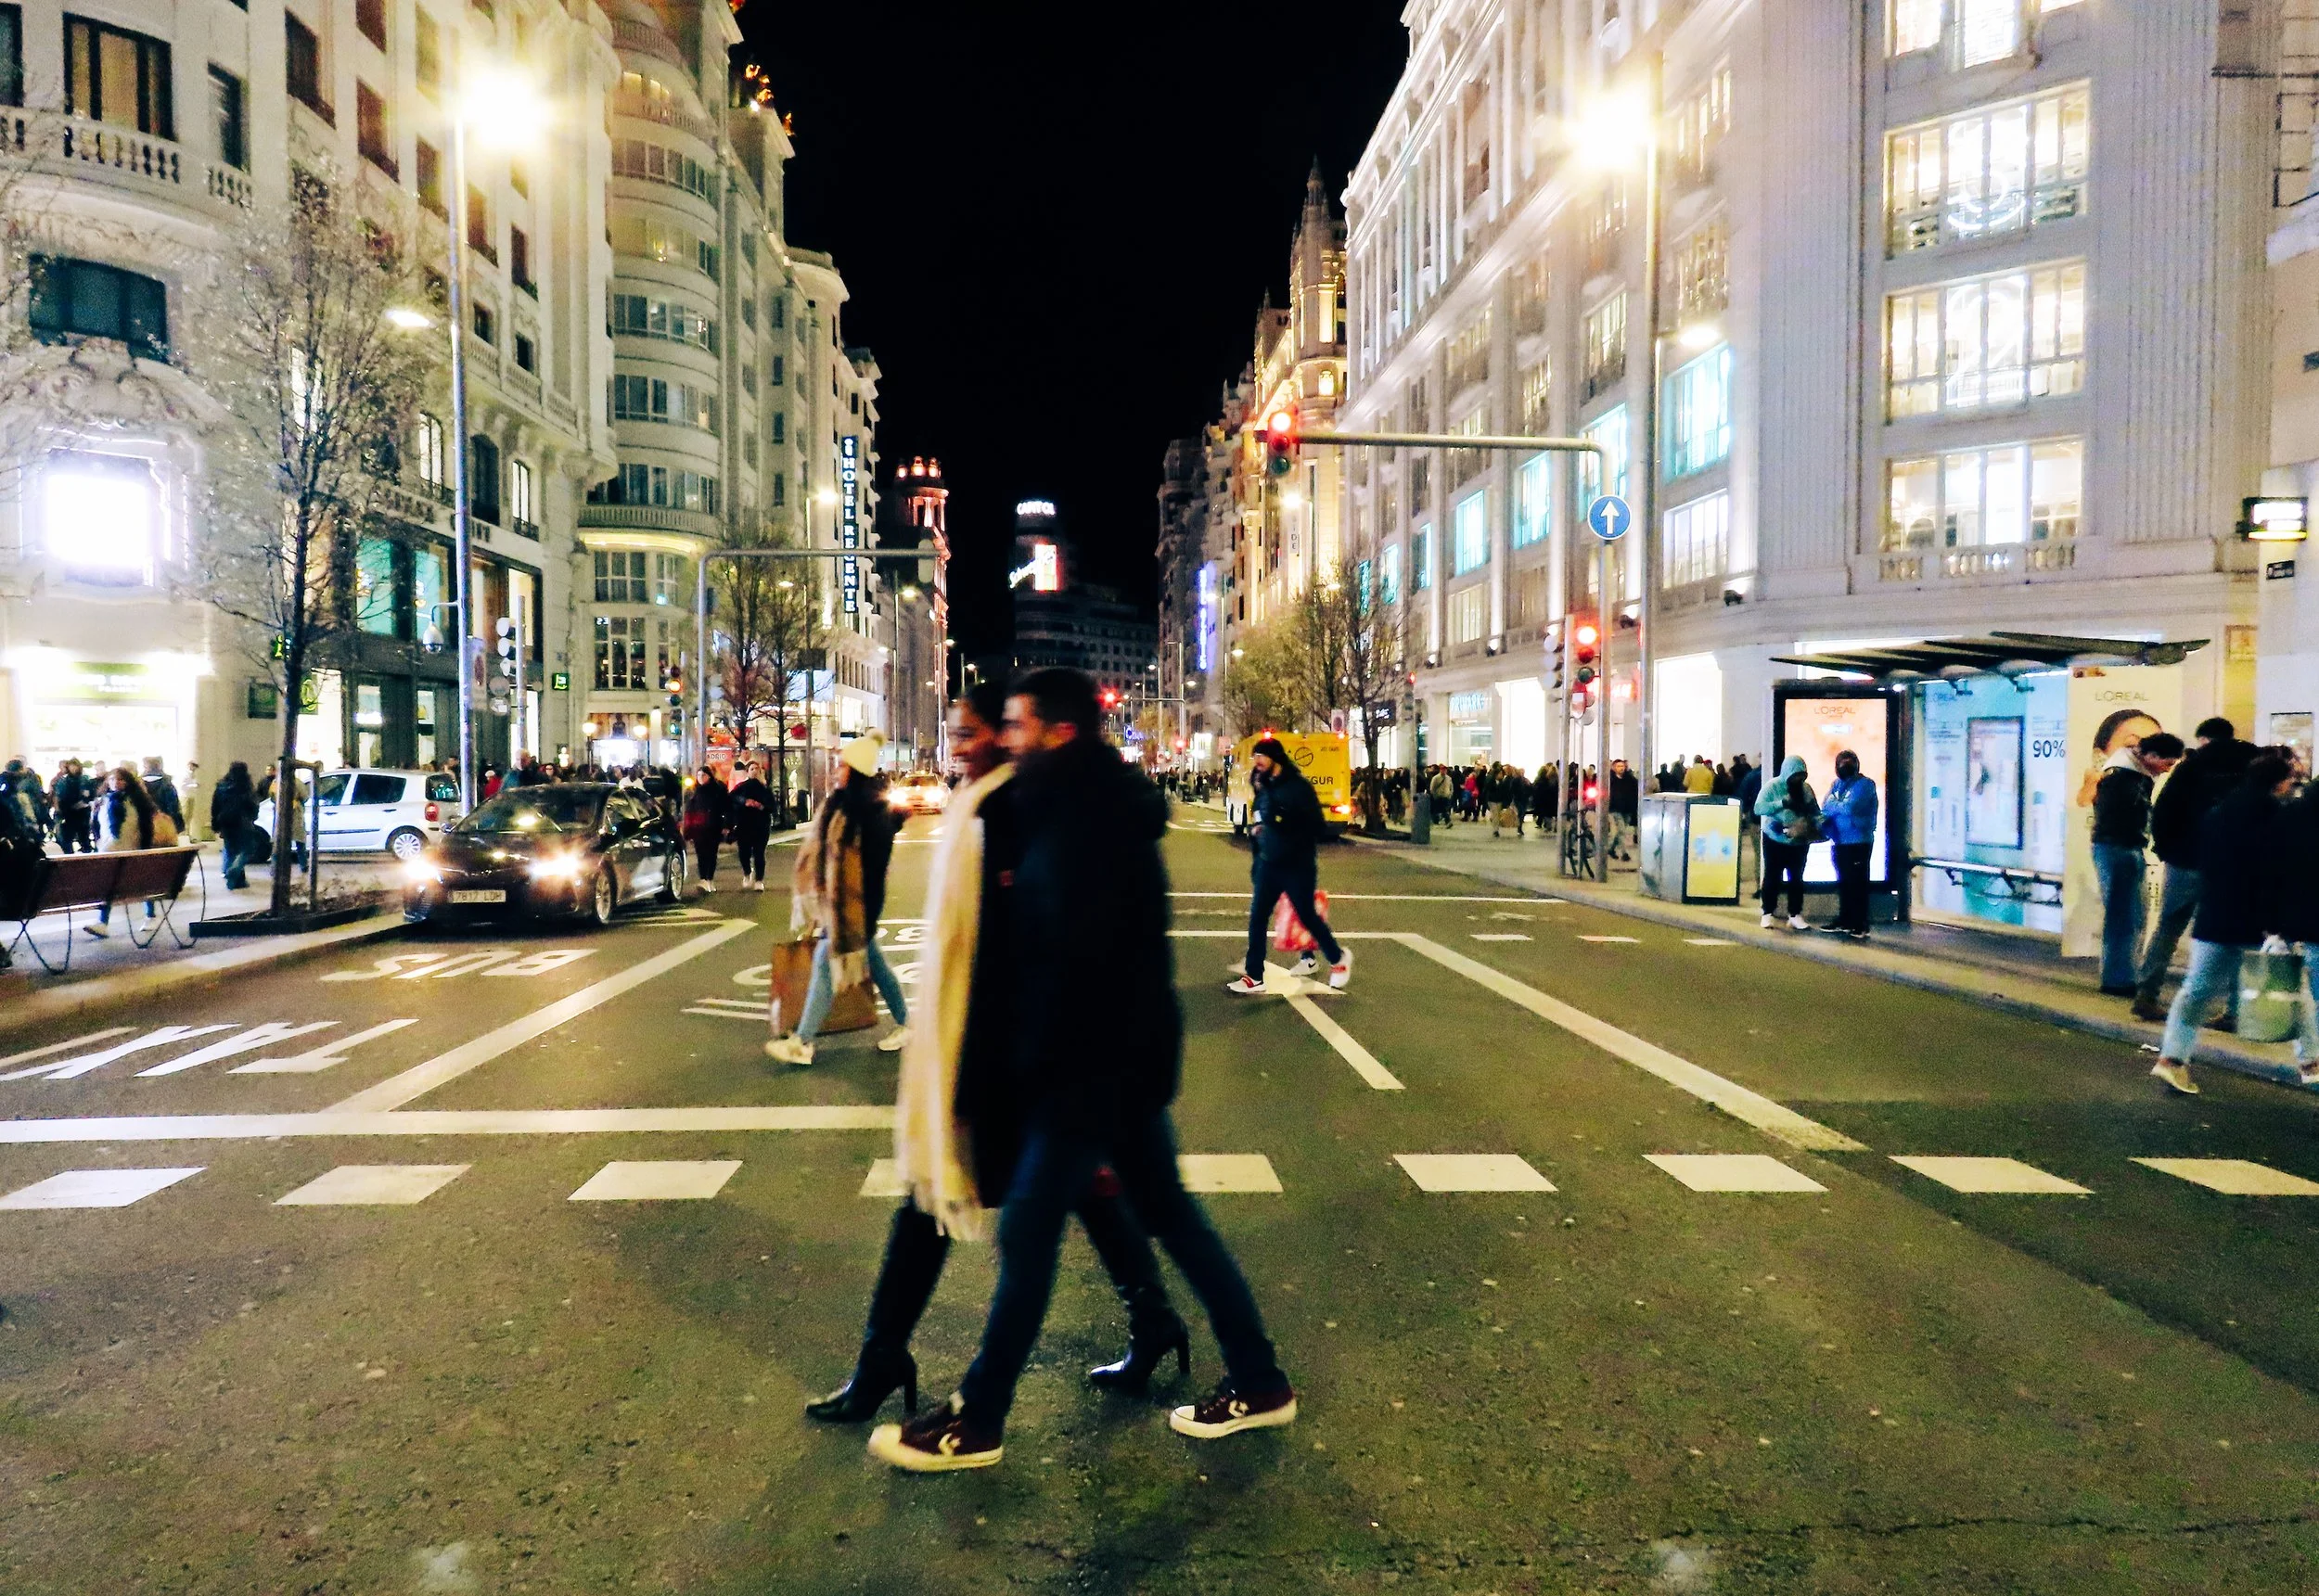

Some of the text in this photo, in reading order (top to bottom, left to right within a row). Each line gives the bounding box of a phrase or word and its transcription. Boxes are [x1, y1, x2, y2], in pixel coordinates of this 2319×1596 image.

[842, 457, 855, 520] HOTEL
[2032, 740, 2066, 759] 90%
[320, 949, 598, 981] BUS
